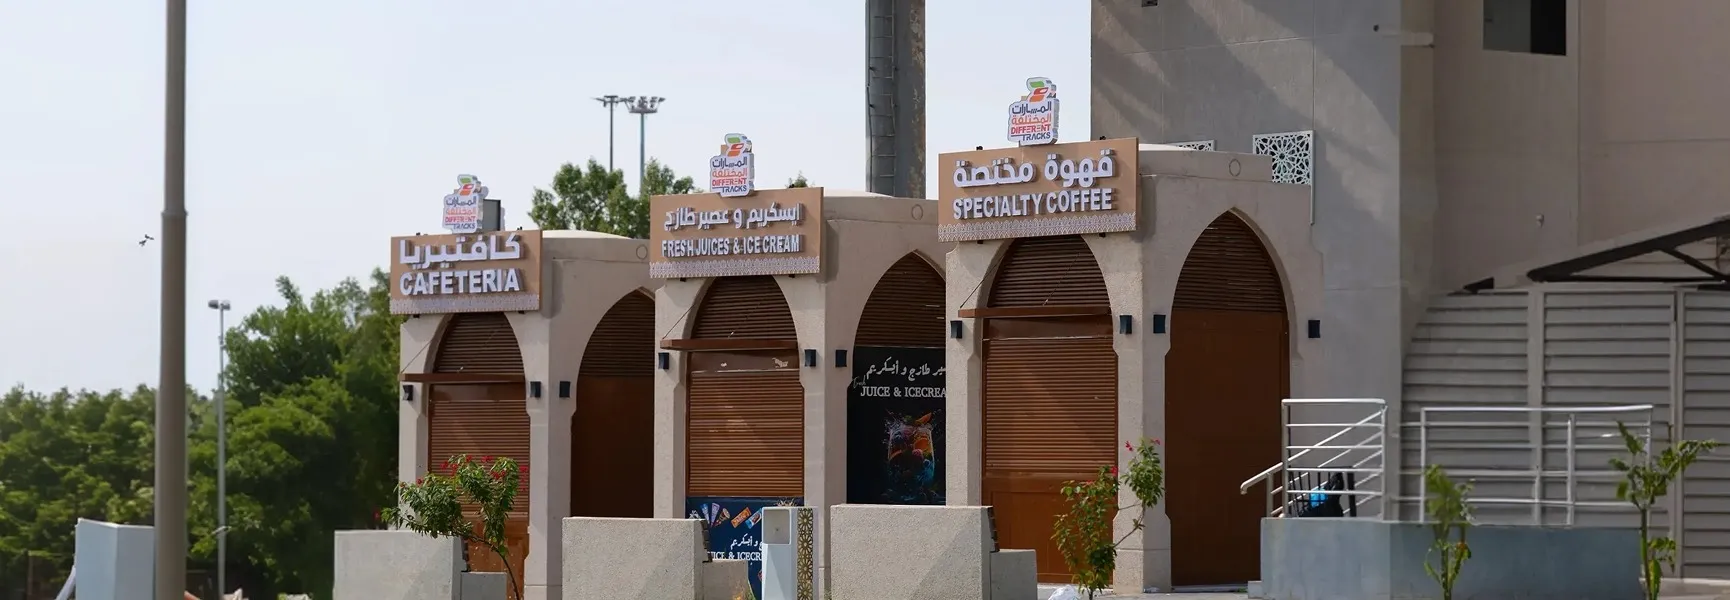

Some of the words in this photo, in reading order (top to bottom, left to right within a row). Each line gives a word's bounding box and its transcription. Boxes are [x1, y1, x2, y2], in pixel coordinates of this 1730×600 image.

[1012, 101, 1052, 116] المسارات
[1011, 114, 1052, 126] المختلفة
[1011, 124, 1051, 135] DIFFERENT
[1022, 132, 1051, 141] TRACKS
[712, 156, 748, 170] المسارات
[1044, 149, 1113, 188] قهوة
[953, 158, 1035, 188] مختصة
[712, 178, 748, 187] DIFFERENT
[721, 185, 748, 193] TRACKS
[953, 193, 1042, 220] SPECIALTY
[1046, 188, 1112, 214] COFFEE
[664, 206, 695, 231] طازج
[697, 208, 729, 230] عصير
[733, 208, 743, 229] و
[400, 233, 520, 270] كافتيريا
[661, 239, 694, 258] FRESH
[695, 237, 730, 256] JUICES
[733, 236, 743, 254] &
[743, 235, 761, 254] ICE
[763, 234, 800, 253] CREAM
[400, 267, 520, 295] CAFETERIA
[908, 363, 931, 381] طازج
[860, 386, 890, 397] JUICE
[893, 386, 902, 397] &
[904, 386, 946, 398] ICECREA
[728, 551, 735, 560] &
